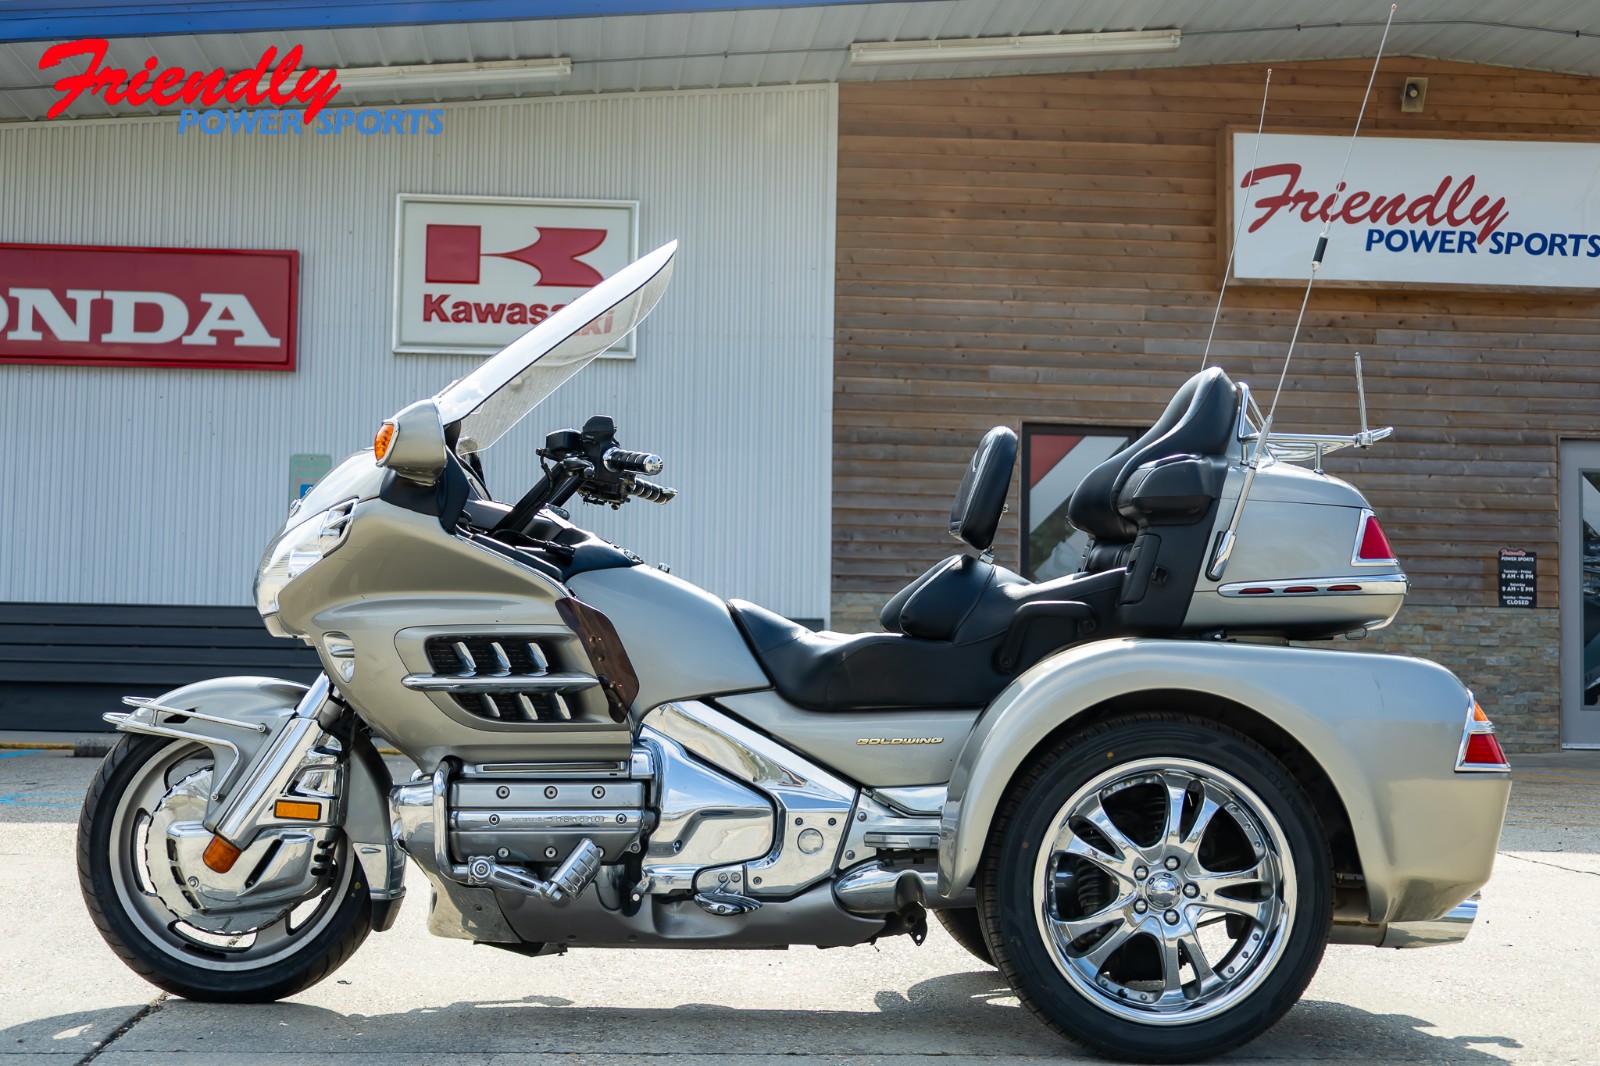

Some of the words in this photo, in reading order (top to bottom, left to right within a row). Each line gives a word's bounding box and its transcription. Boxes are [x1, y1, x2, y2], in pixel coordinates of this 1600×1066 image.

[1240, 163, 1509, 245] Friendly
[1365, 229, 1478, 254] POWER
[1489, 232, 1600, 258] SPORTS
[0, 287, 281, 347] NDA
[422, 294, 615, 336] Kawaski
